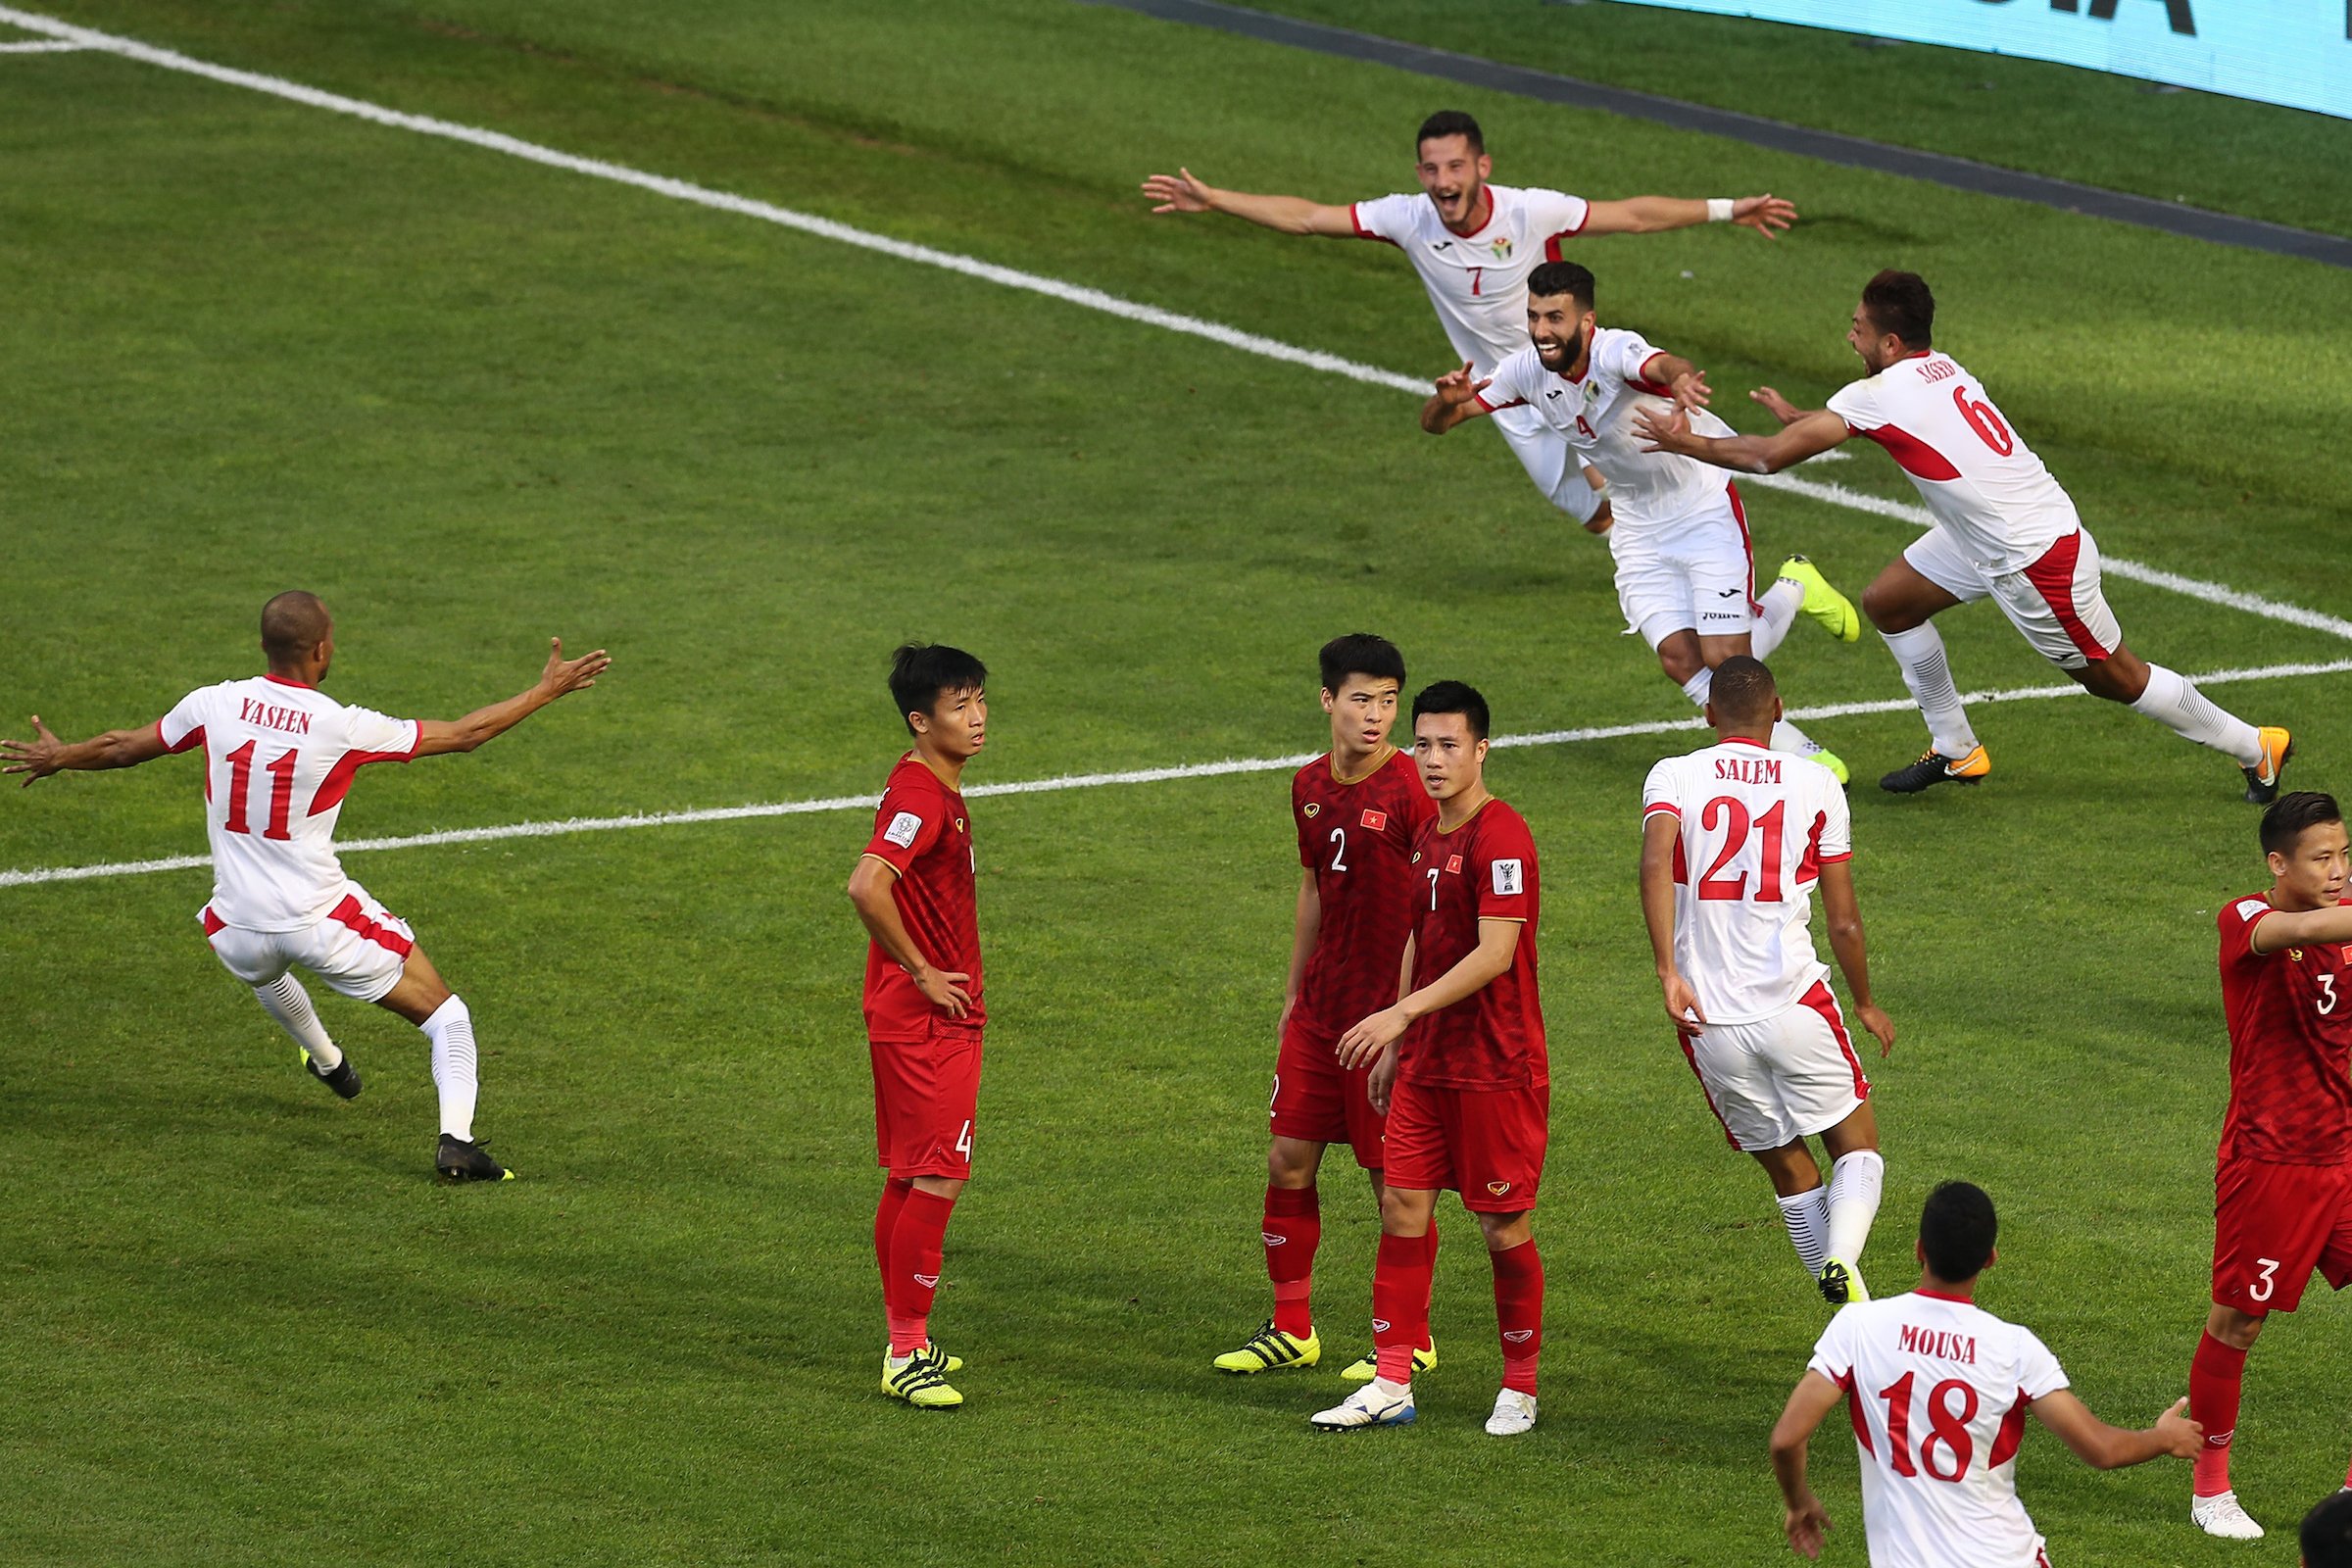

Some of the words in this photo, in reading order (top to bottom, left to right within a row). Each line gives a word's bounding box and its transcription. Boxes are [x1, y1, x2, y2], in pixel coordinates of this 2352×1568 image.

[1466, 267, 1482, 296] 7
[1916, 361, 1956, 384] SAEED
[1576, 415, 1596, 439] 4
[1953, 385, 2013, 458] 6
[239, 697, 313, 735] YASEEN
[224, 739, 298, 842] 11
[1715, 759, 1783, 785] SALEM
[1330, 827, 1348, 872] 2
[1698, 795, 1786, 903] 21
[1426, 867, 1440, 911] 7
[2317, 973, 2337, 1015] 3
[955, 1119, 971, 1163] 4
[2249, 1257, 2280, 1301] 3
[1897, 1324, 1977, 1365] MOUSA
[1879, 1371, 1980, 1484] 18
